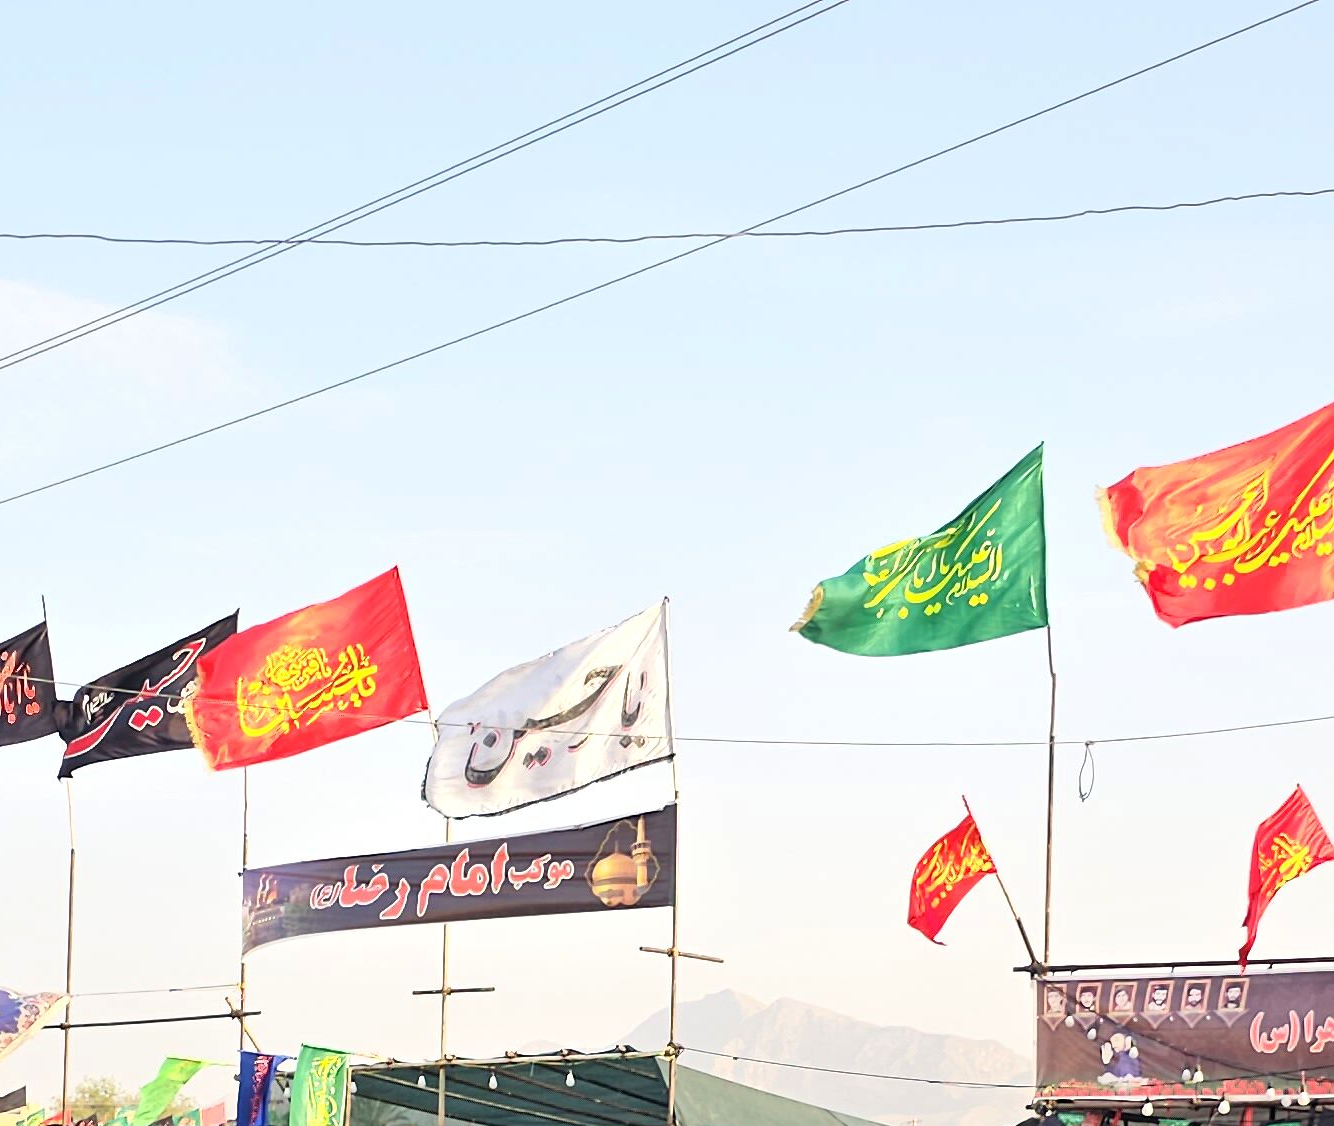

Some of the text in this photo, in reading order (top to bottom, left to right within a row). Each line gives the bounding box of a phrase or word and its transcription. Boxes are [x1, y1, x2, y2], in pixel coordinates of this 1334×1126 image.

[339, 862, 409, 920] رضا
[417, 842, 509, 917] امام
[508, 853, 574, 889] موکب
[1249, 1009, 1301, 1053] (س)
